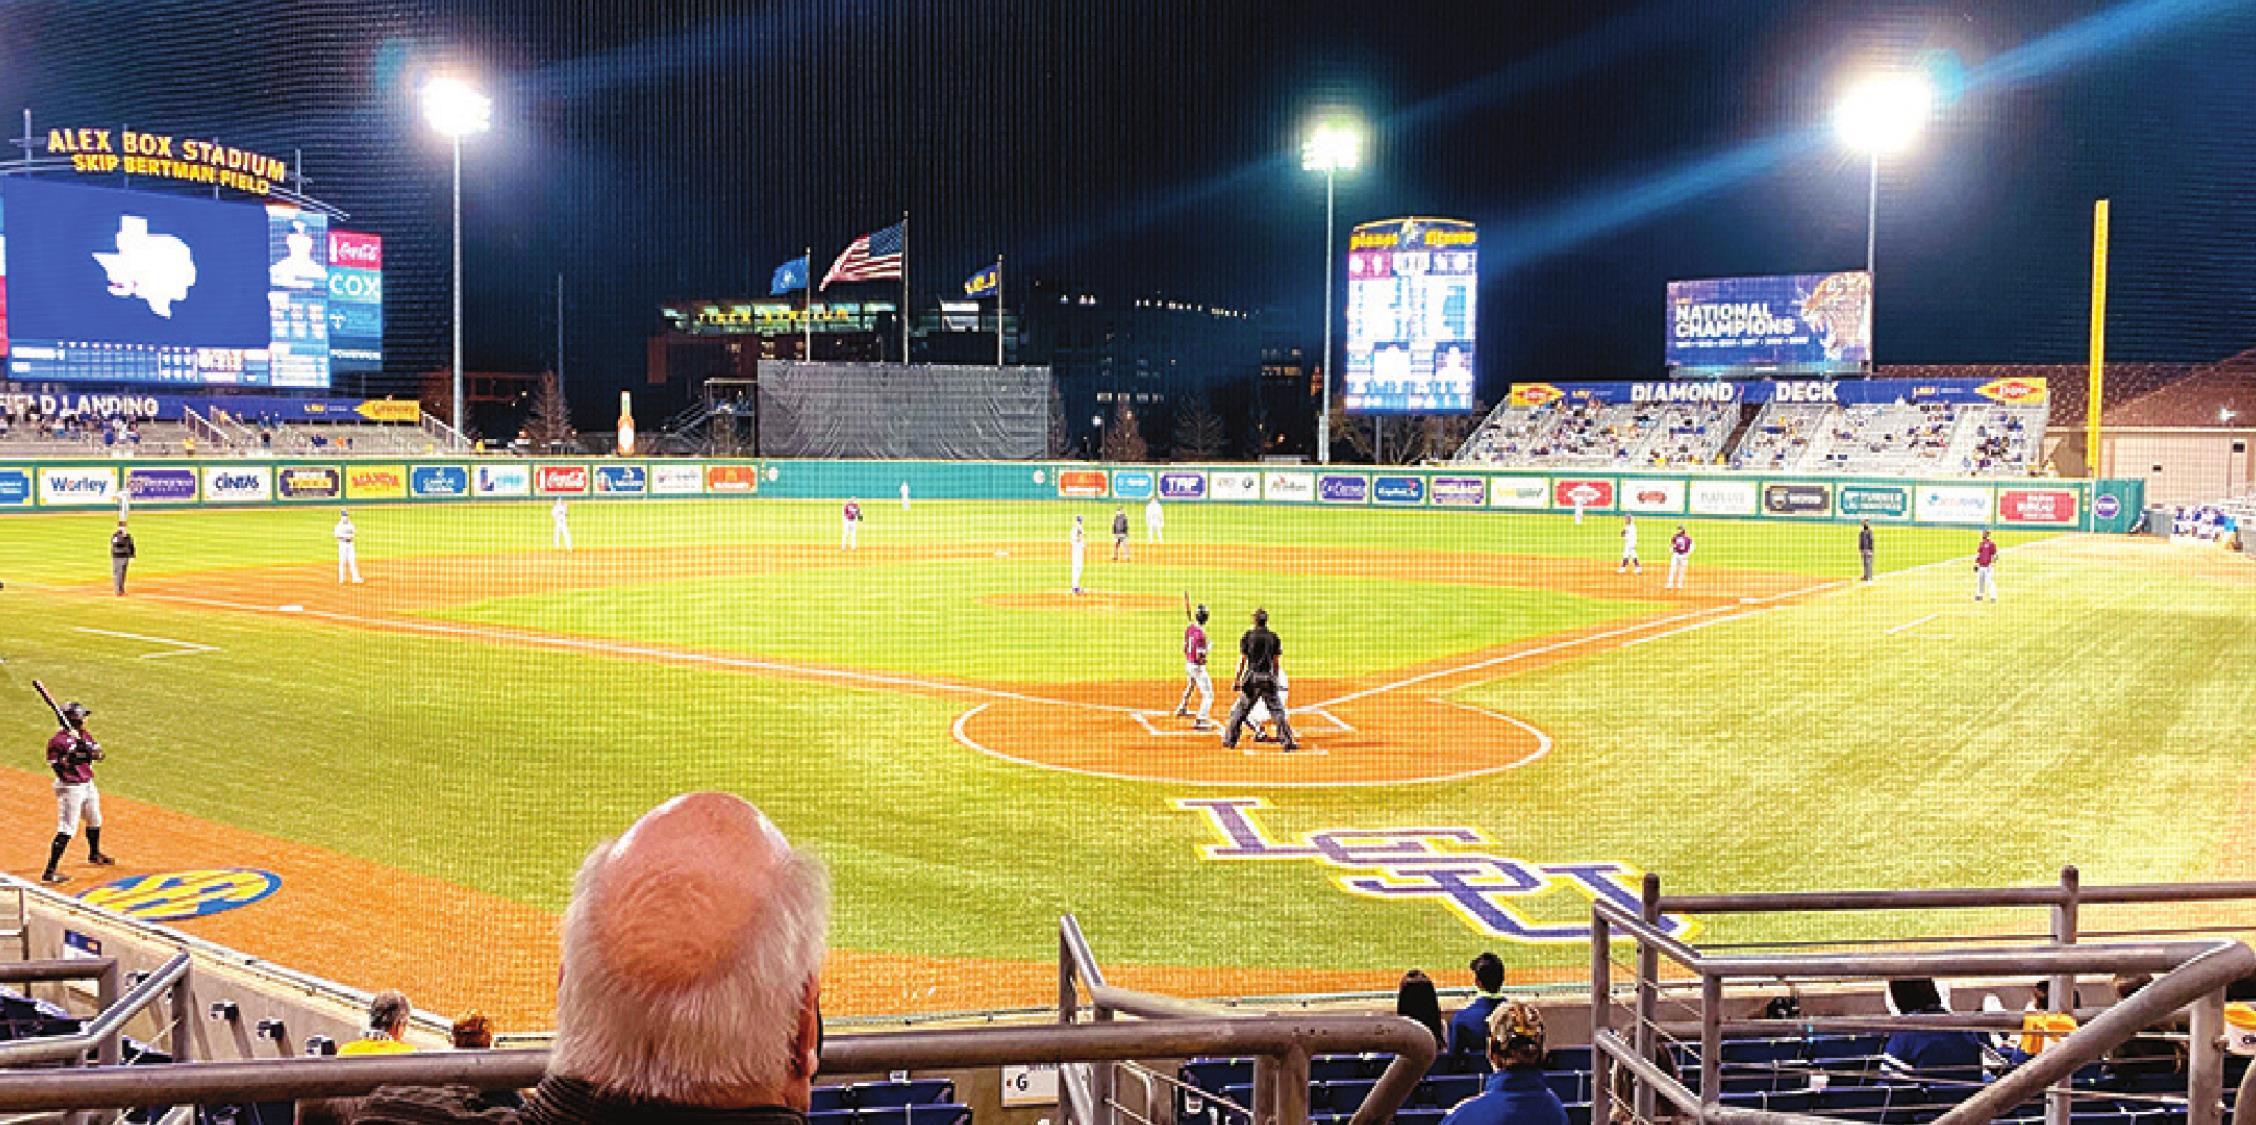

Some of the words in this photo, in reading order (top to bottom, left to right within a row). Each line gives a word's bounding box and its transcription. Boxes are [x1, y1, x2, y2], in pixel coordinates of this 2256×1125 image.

[48, 128, 112, 153] ALEX
[122, 131, 172, 157] BOX
[182, 138, 285, 182] STADIUM
[71, 154, 118, 172] SKIP
[123, 156, 214, 183] BERTMAN
[219, 169, 270, 195] FIELD
[329, 273, 381, 296] COX
[1676, 303, 1773, 321] NATIONAL
[1676, 318, 1796, 337] CHAMPIONS
[1631, 382, 1734, 401] DIAMOND
[1775, 381, 1839, 401] DECK
[60, 394, 159, 416] LANDING
[50, 477, 107, 493] Worley
